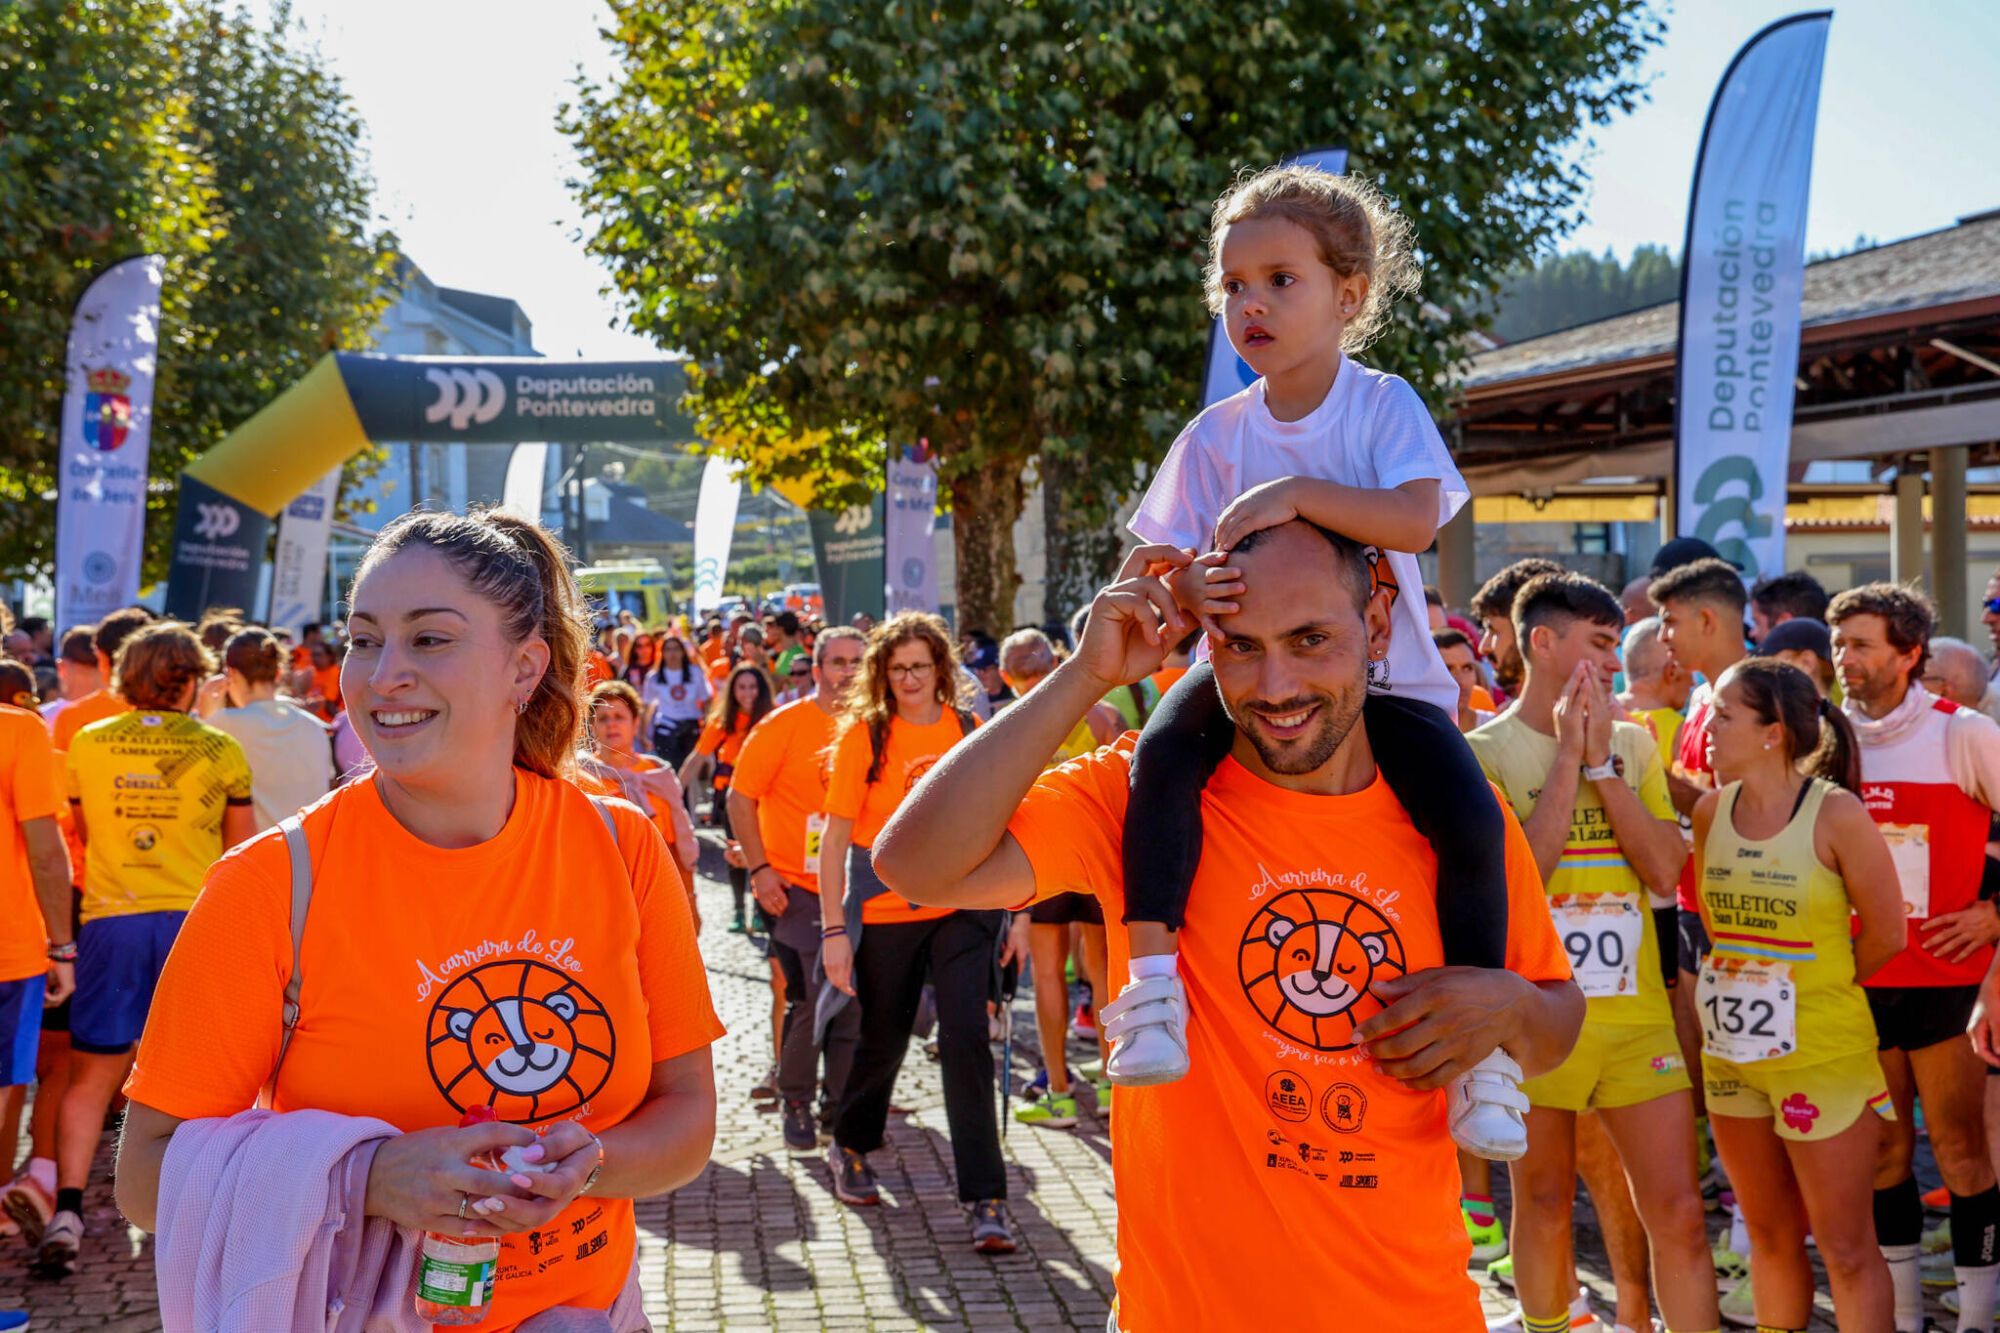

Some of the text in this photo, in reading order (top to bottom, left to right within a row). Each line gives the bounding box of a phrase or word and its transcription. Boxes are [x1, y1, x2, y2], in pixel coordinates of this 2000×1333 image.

[1708, 200, 1745, 432] Deputación
[1743, 202, 1778, 433] Pontevedra
[516, 373, 654, 398] Deputación
[516, 397, 655, 416] Pontevedra
[95, 734, 127, 744] CLUB
[1350, 872, 1371, 897] de
[1373, 888, 1402, 924] Leo
[1713, 909, 1778, 930] San Lázaro
[1564, 930, 1623, 968] 90
[416, 929, 583, 1003] A carreira de Leo
[1705, 995, 1776, 1037] 132
[1271, 1091, 1307, 1108] AEEA
[505, 1270, 532, 1281] GALICIA
